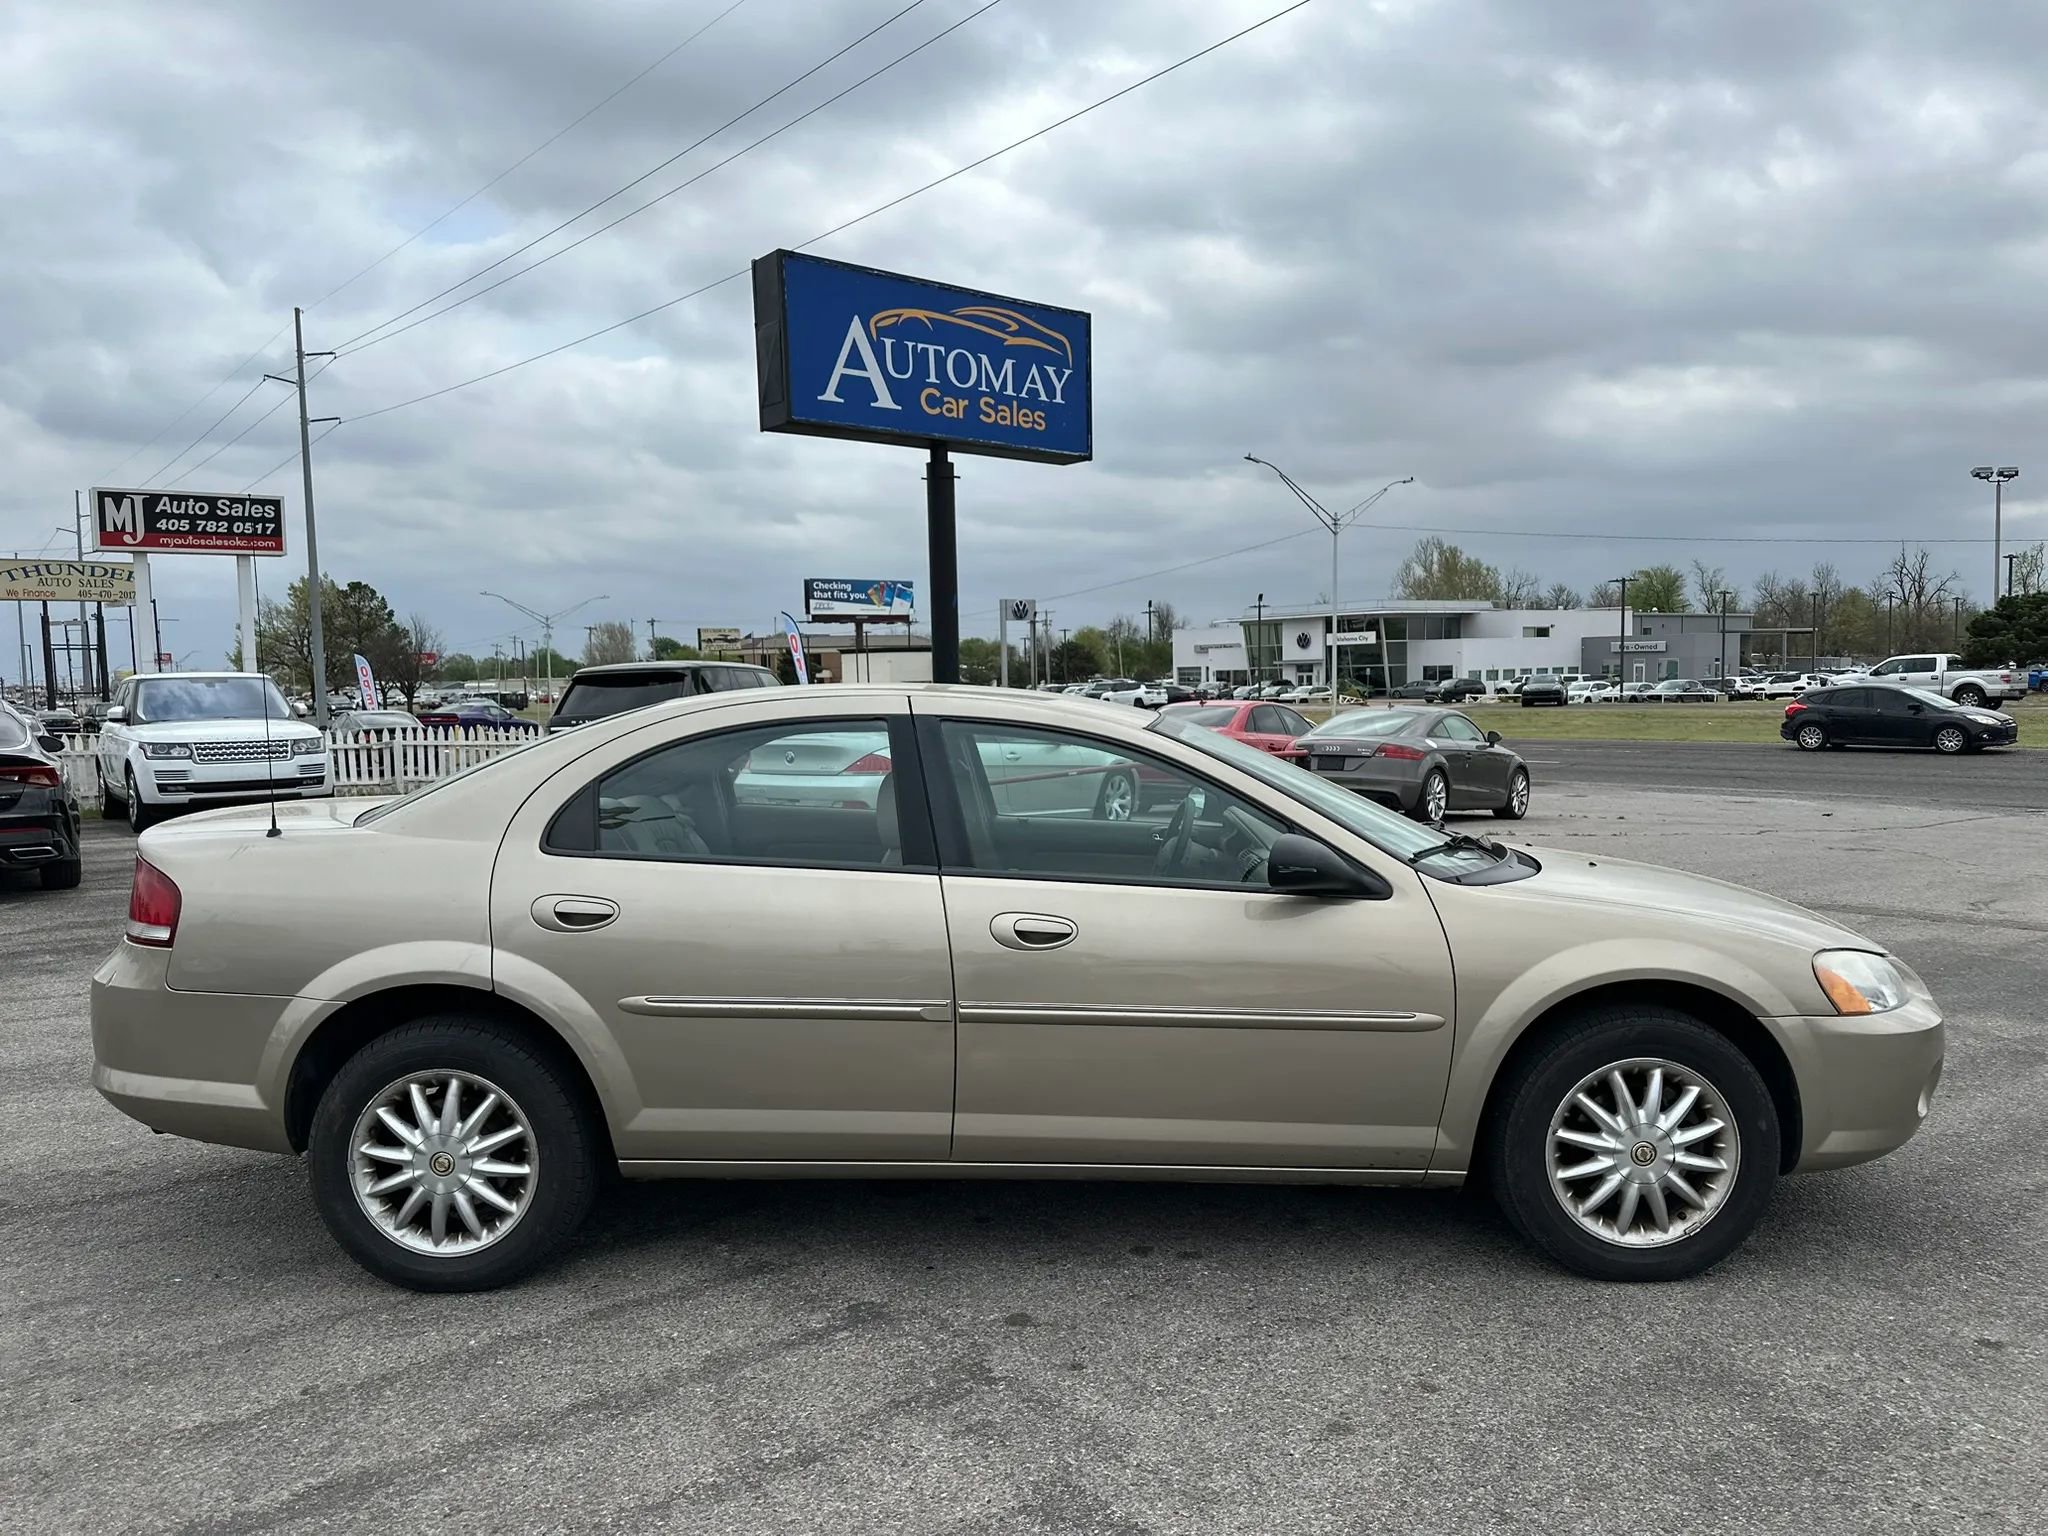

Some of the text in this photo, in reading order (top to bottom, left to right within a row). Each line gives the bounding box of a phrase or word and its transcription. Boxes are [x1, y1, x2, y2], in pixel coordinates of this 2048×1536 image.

[817, 314, 1073, 410] AUTOMAY
[919, 387, 1046, 431] Car Sales
[155, 496, 275, 518] Auto Sales
[104, 494, 150, 544] MJ
[156, 519, 275, 535] 405 782 0517
[159, 535, 275, 548] mjautosalesokc.com
[38, 577, 114, 589] AUTO SALES
[813, 581, 851, 591] Checking
[6, 588, 56, 598] We Finance
[813, 590, 868, 600] that fits you.
